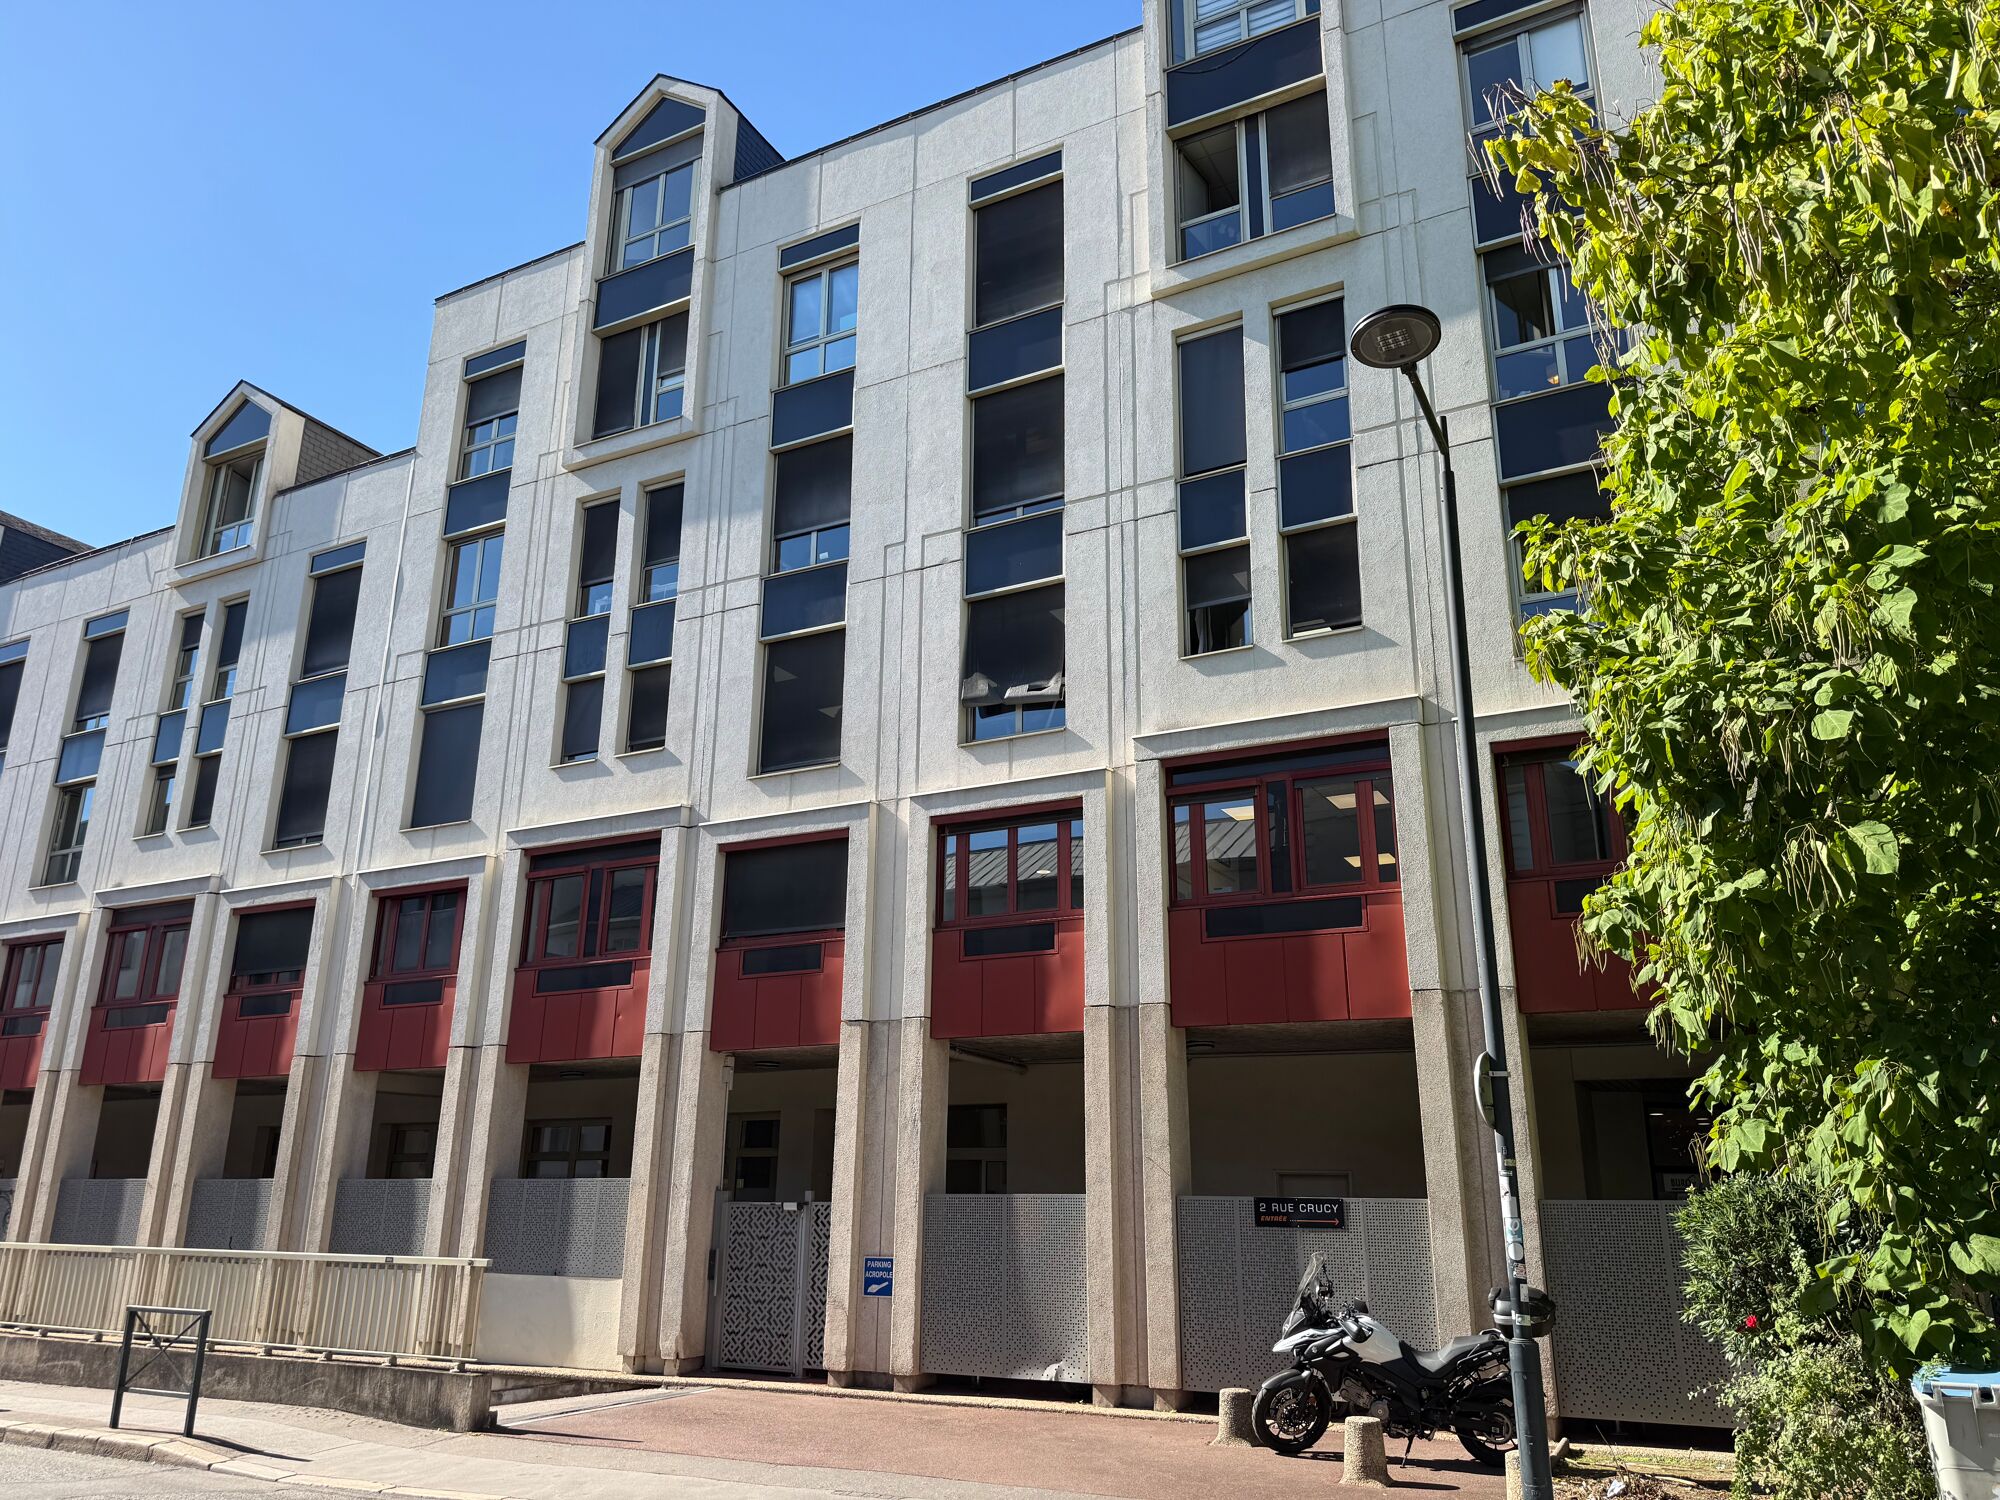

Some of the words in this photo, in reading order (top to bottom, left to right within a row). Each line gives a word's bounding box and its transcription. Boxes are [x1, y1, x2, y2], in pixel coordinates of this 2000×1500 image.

[1259, 1202, 1267, 1212] 2
[1271, 1203, 1294, 1213] RUE
[1299, 1203, 1339, 1213] CRUCY
[867, 1260, 891, 1268] PARKING
[865, 1270, 893, 1278] ACROPOLE
